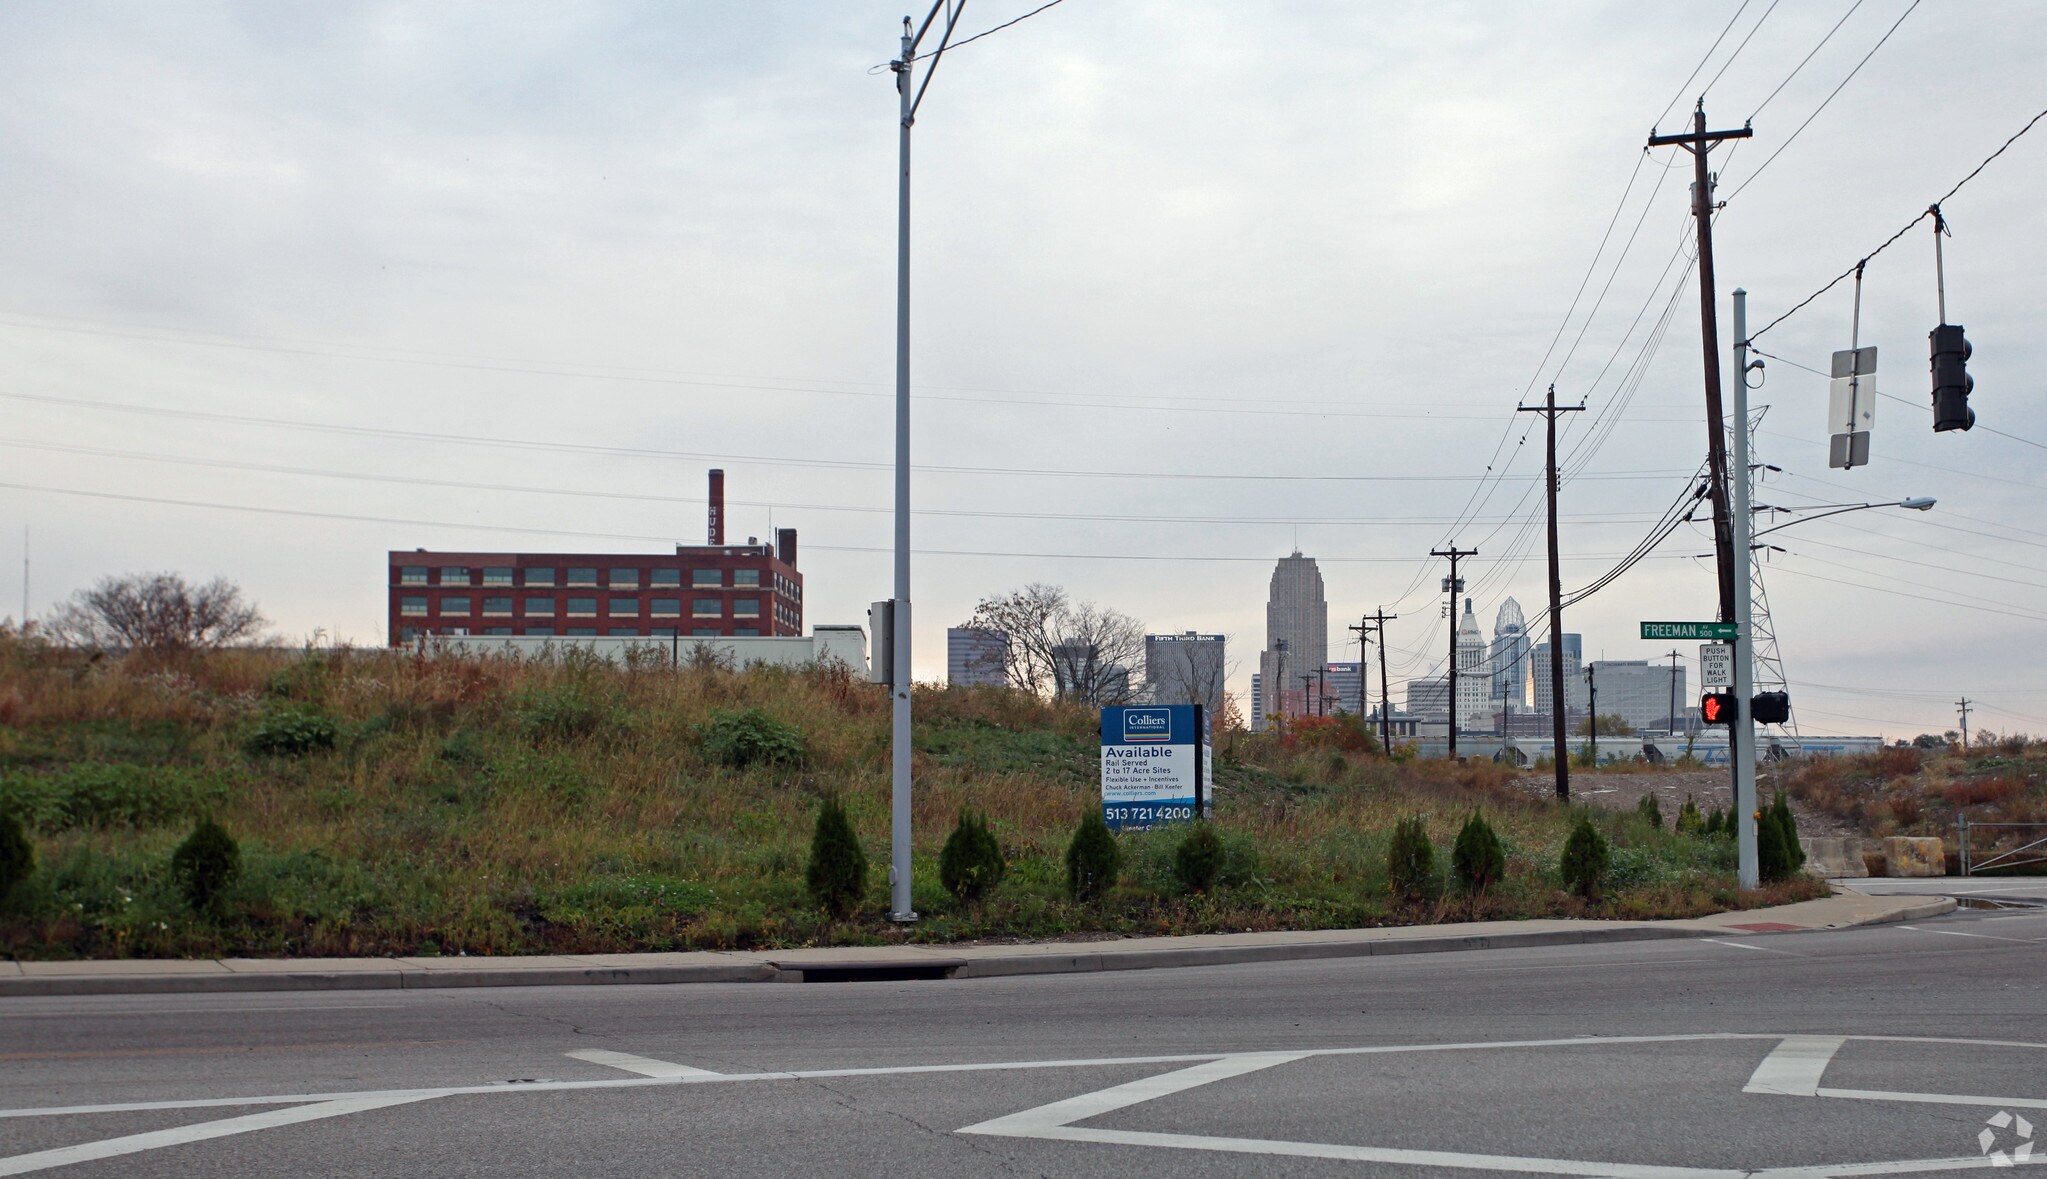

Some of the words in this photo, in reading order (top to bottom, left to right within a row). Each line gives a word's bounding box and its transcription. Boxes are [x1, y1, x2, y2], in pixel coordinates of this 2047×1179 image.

[1644, 624, 1696, 637] FREEMAN
[1707, 676, 1727, 684] LIGHT
[1128, 714, 1166, 726] Colliers
[1105, 746, 1173, 758] Available
[1105, 759, 1120, 767] Rail
[1121, 759, 1148, 767] Served
[1105, 767, 1111, 775] 2
[1152, 766, 1172, 774] Sites
[1106, 808, 1128, 820] 513
[1131, 808, 1153, 820] 721
[1156, 807, 1191, 819] 4200
